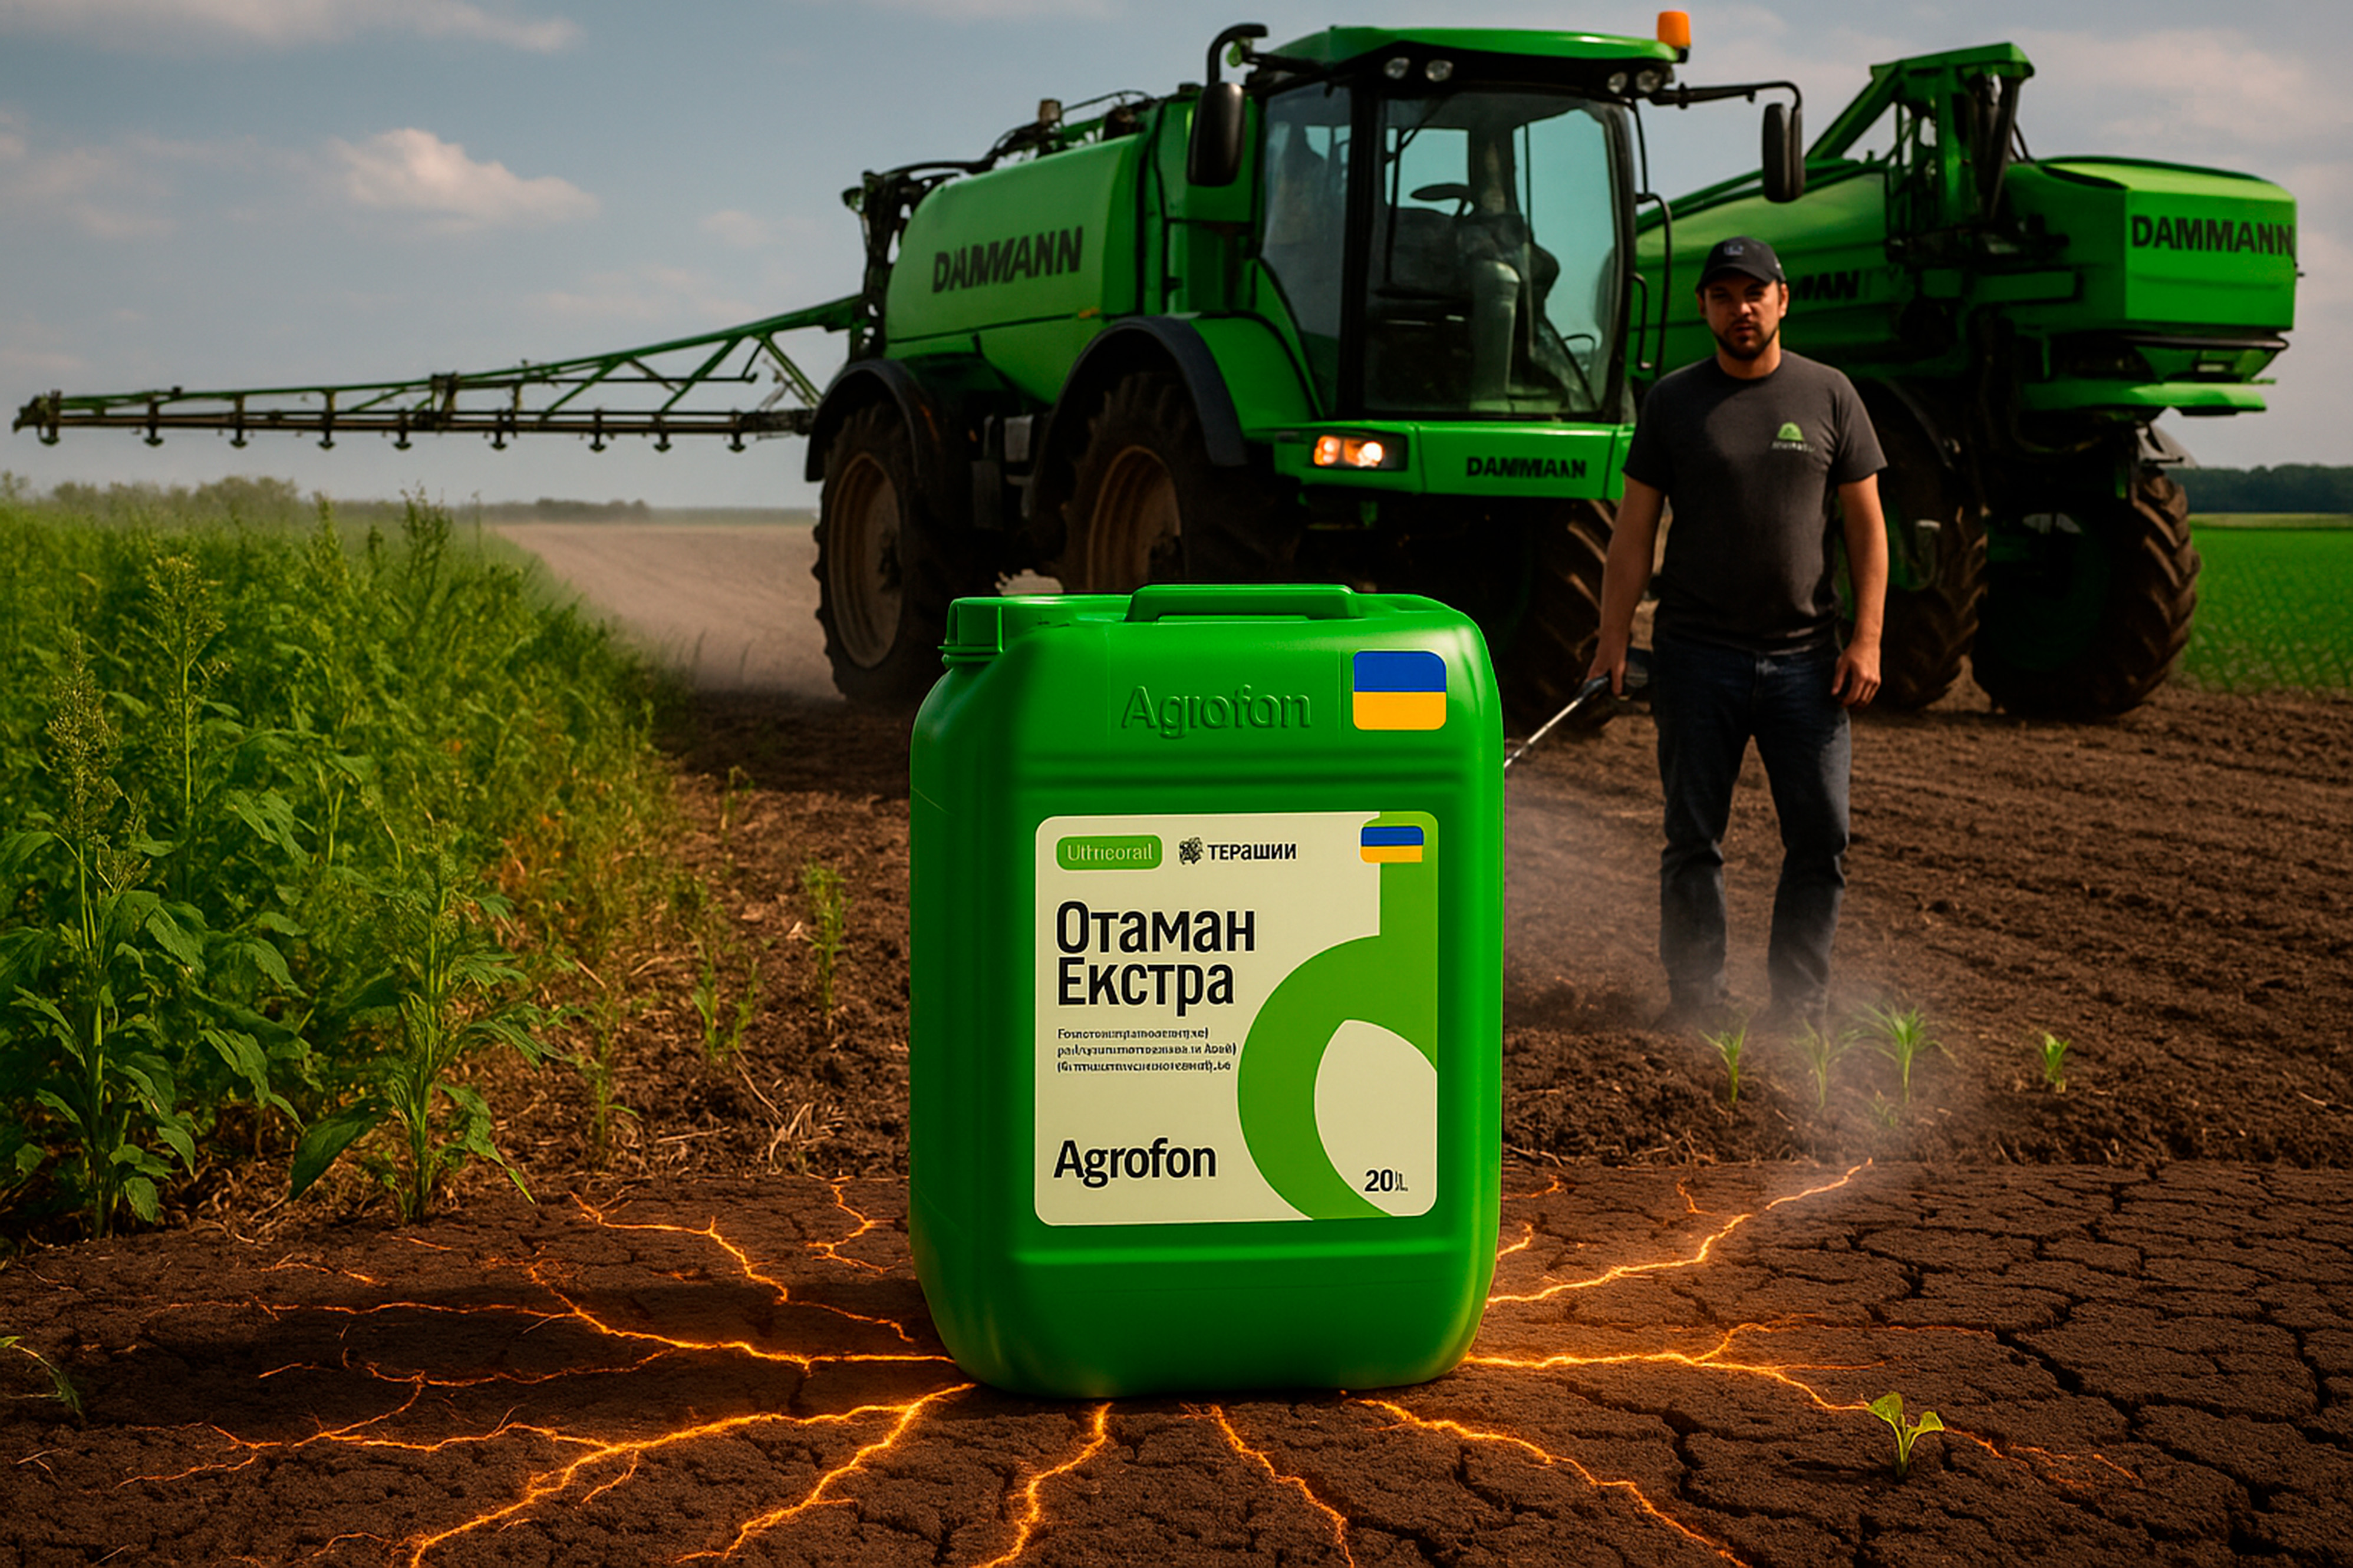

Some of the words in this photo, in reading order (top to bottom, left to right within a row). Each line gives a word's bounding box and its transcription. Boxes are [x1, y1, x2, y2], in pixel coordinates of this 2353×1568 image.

[2131, 215, 2294, 256] DAMMANN
[1121, 684, 1312, 739] Agrofon
[1056, 901, 1255, 953] Отаман
[1058, 957, 1235, 1017] Екстра
[1053, 1138, 1217, 1189] Agrofon
